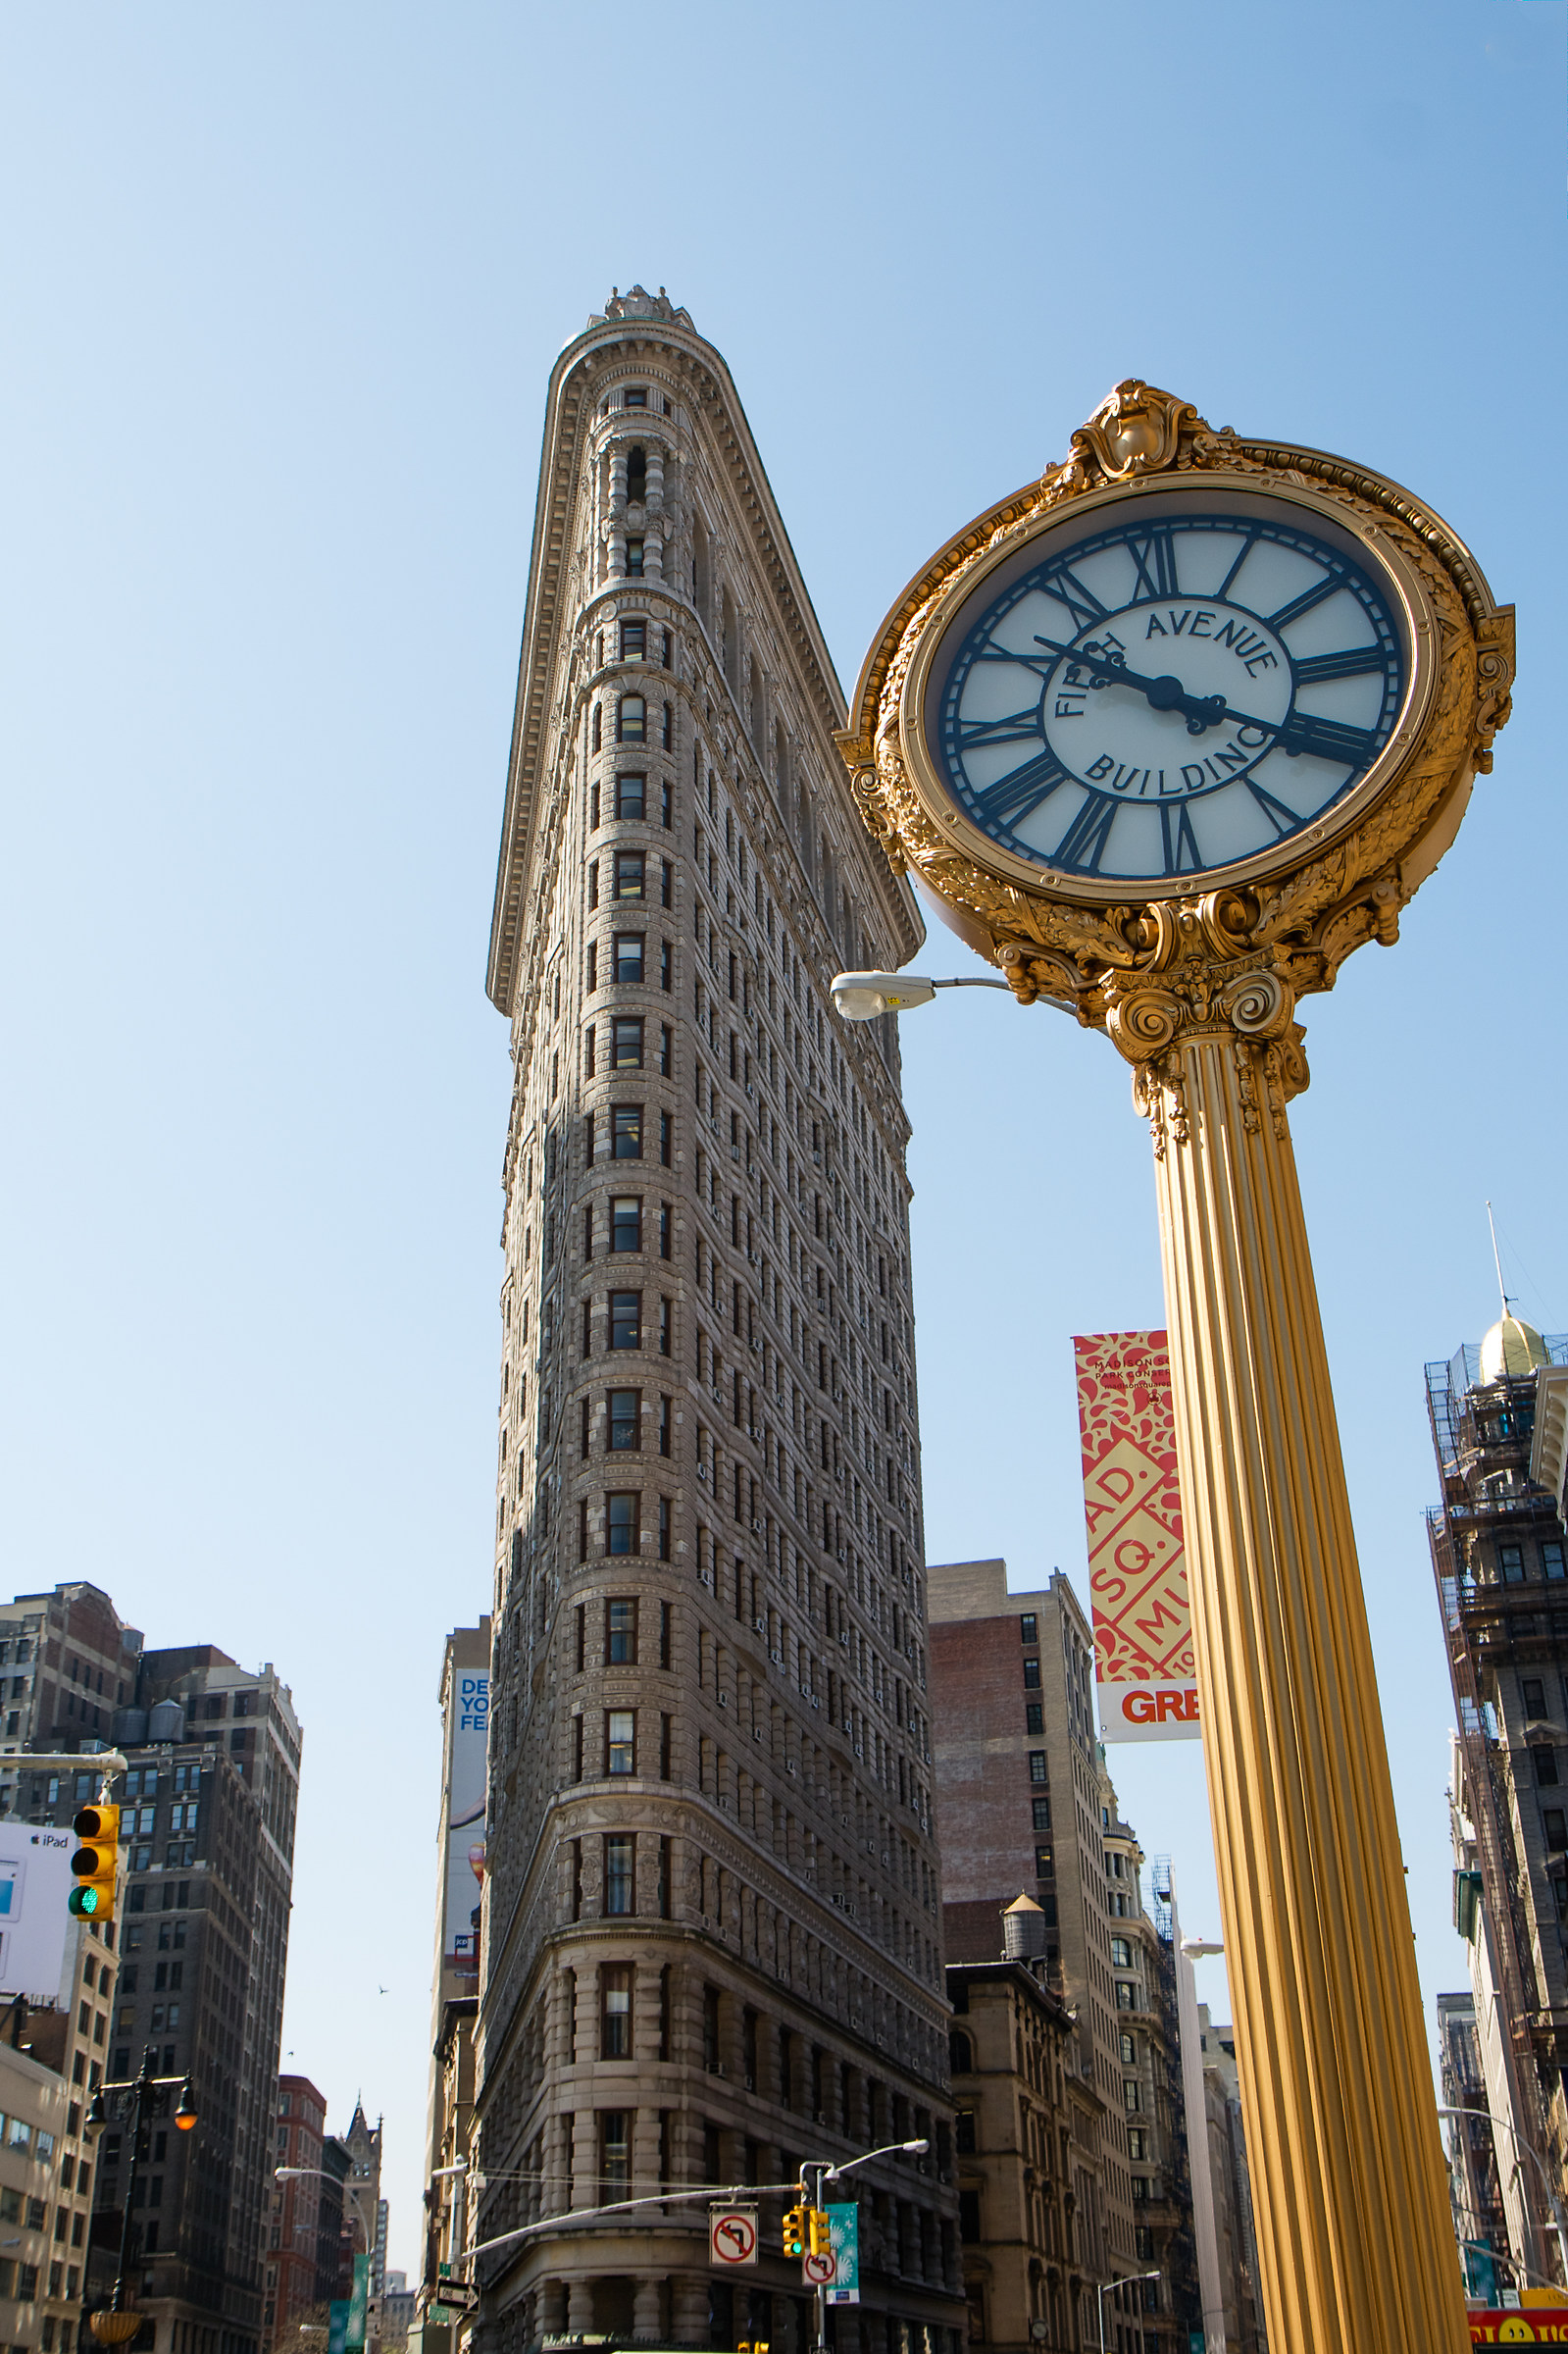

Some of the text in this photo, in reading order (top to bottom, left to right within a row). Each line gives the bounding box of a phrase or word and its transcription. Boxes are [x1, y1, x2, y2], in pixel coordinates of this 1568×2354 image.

[1055, 610, 1278, 718] FIFH AVENUE
[1085, 724, 1270, 795] BUILDING
[1094, 1358, 1152, 1369] MADISON
[1090, 1539, 1166, 1604] SQ.
[462, 1679, 488, 1695] DE
[460, 1697, 488, 1713] YO
[461, 1714, 488, 1731] FE
[42, 1834, 69, 1849] iPad
